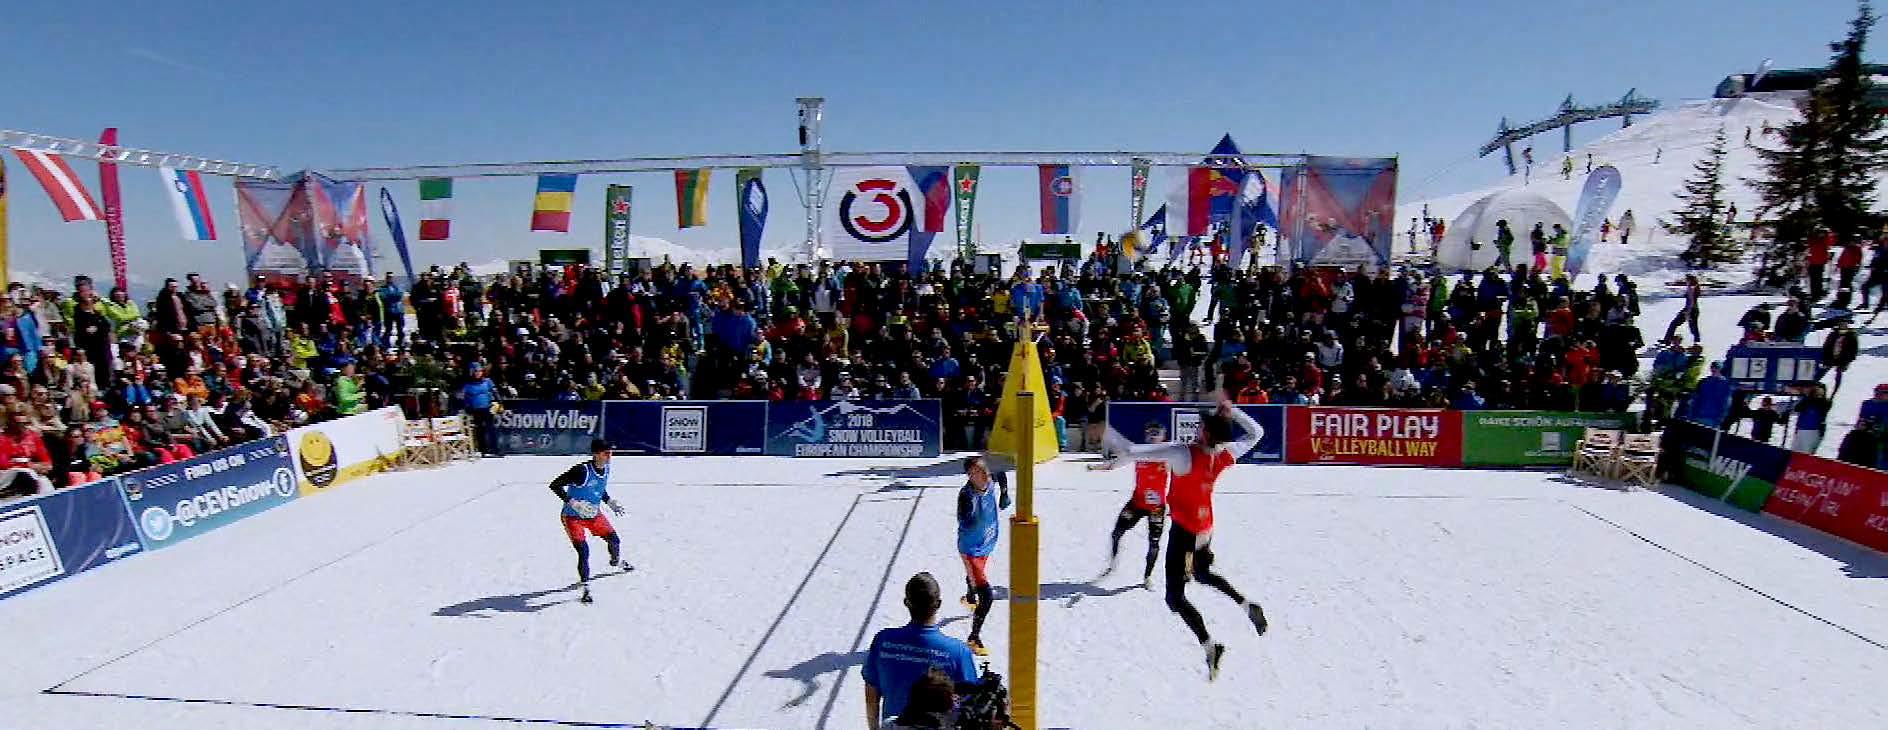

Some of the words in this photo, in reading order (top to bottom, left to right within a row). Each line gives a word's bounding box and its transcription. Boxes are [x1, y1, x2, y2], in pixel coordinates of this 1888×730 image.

[495, 409, 598, 434] oSnowVolley
[847, 414, 873, 427] 2018
[1310, 412, 1369, 437] FAIR
[1376, 414, 1439, 439] PLAY
[828, 429, 861, 443] SNOW
[862, 429, 923, 443] VOLLEYBALL
[795, 443, 848, 457] EUROPEAN
[850, 443, 924, 457] CHAMPIONSHIP
[1405, 440, 1439, 457] WAY
[175, 479, 272, 527] @CEVSnow
[0, 528, 35, 547] NOW
